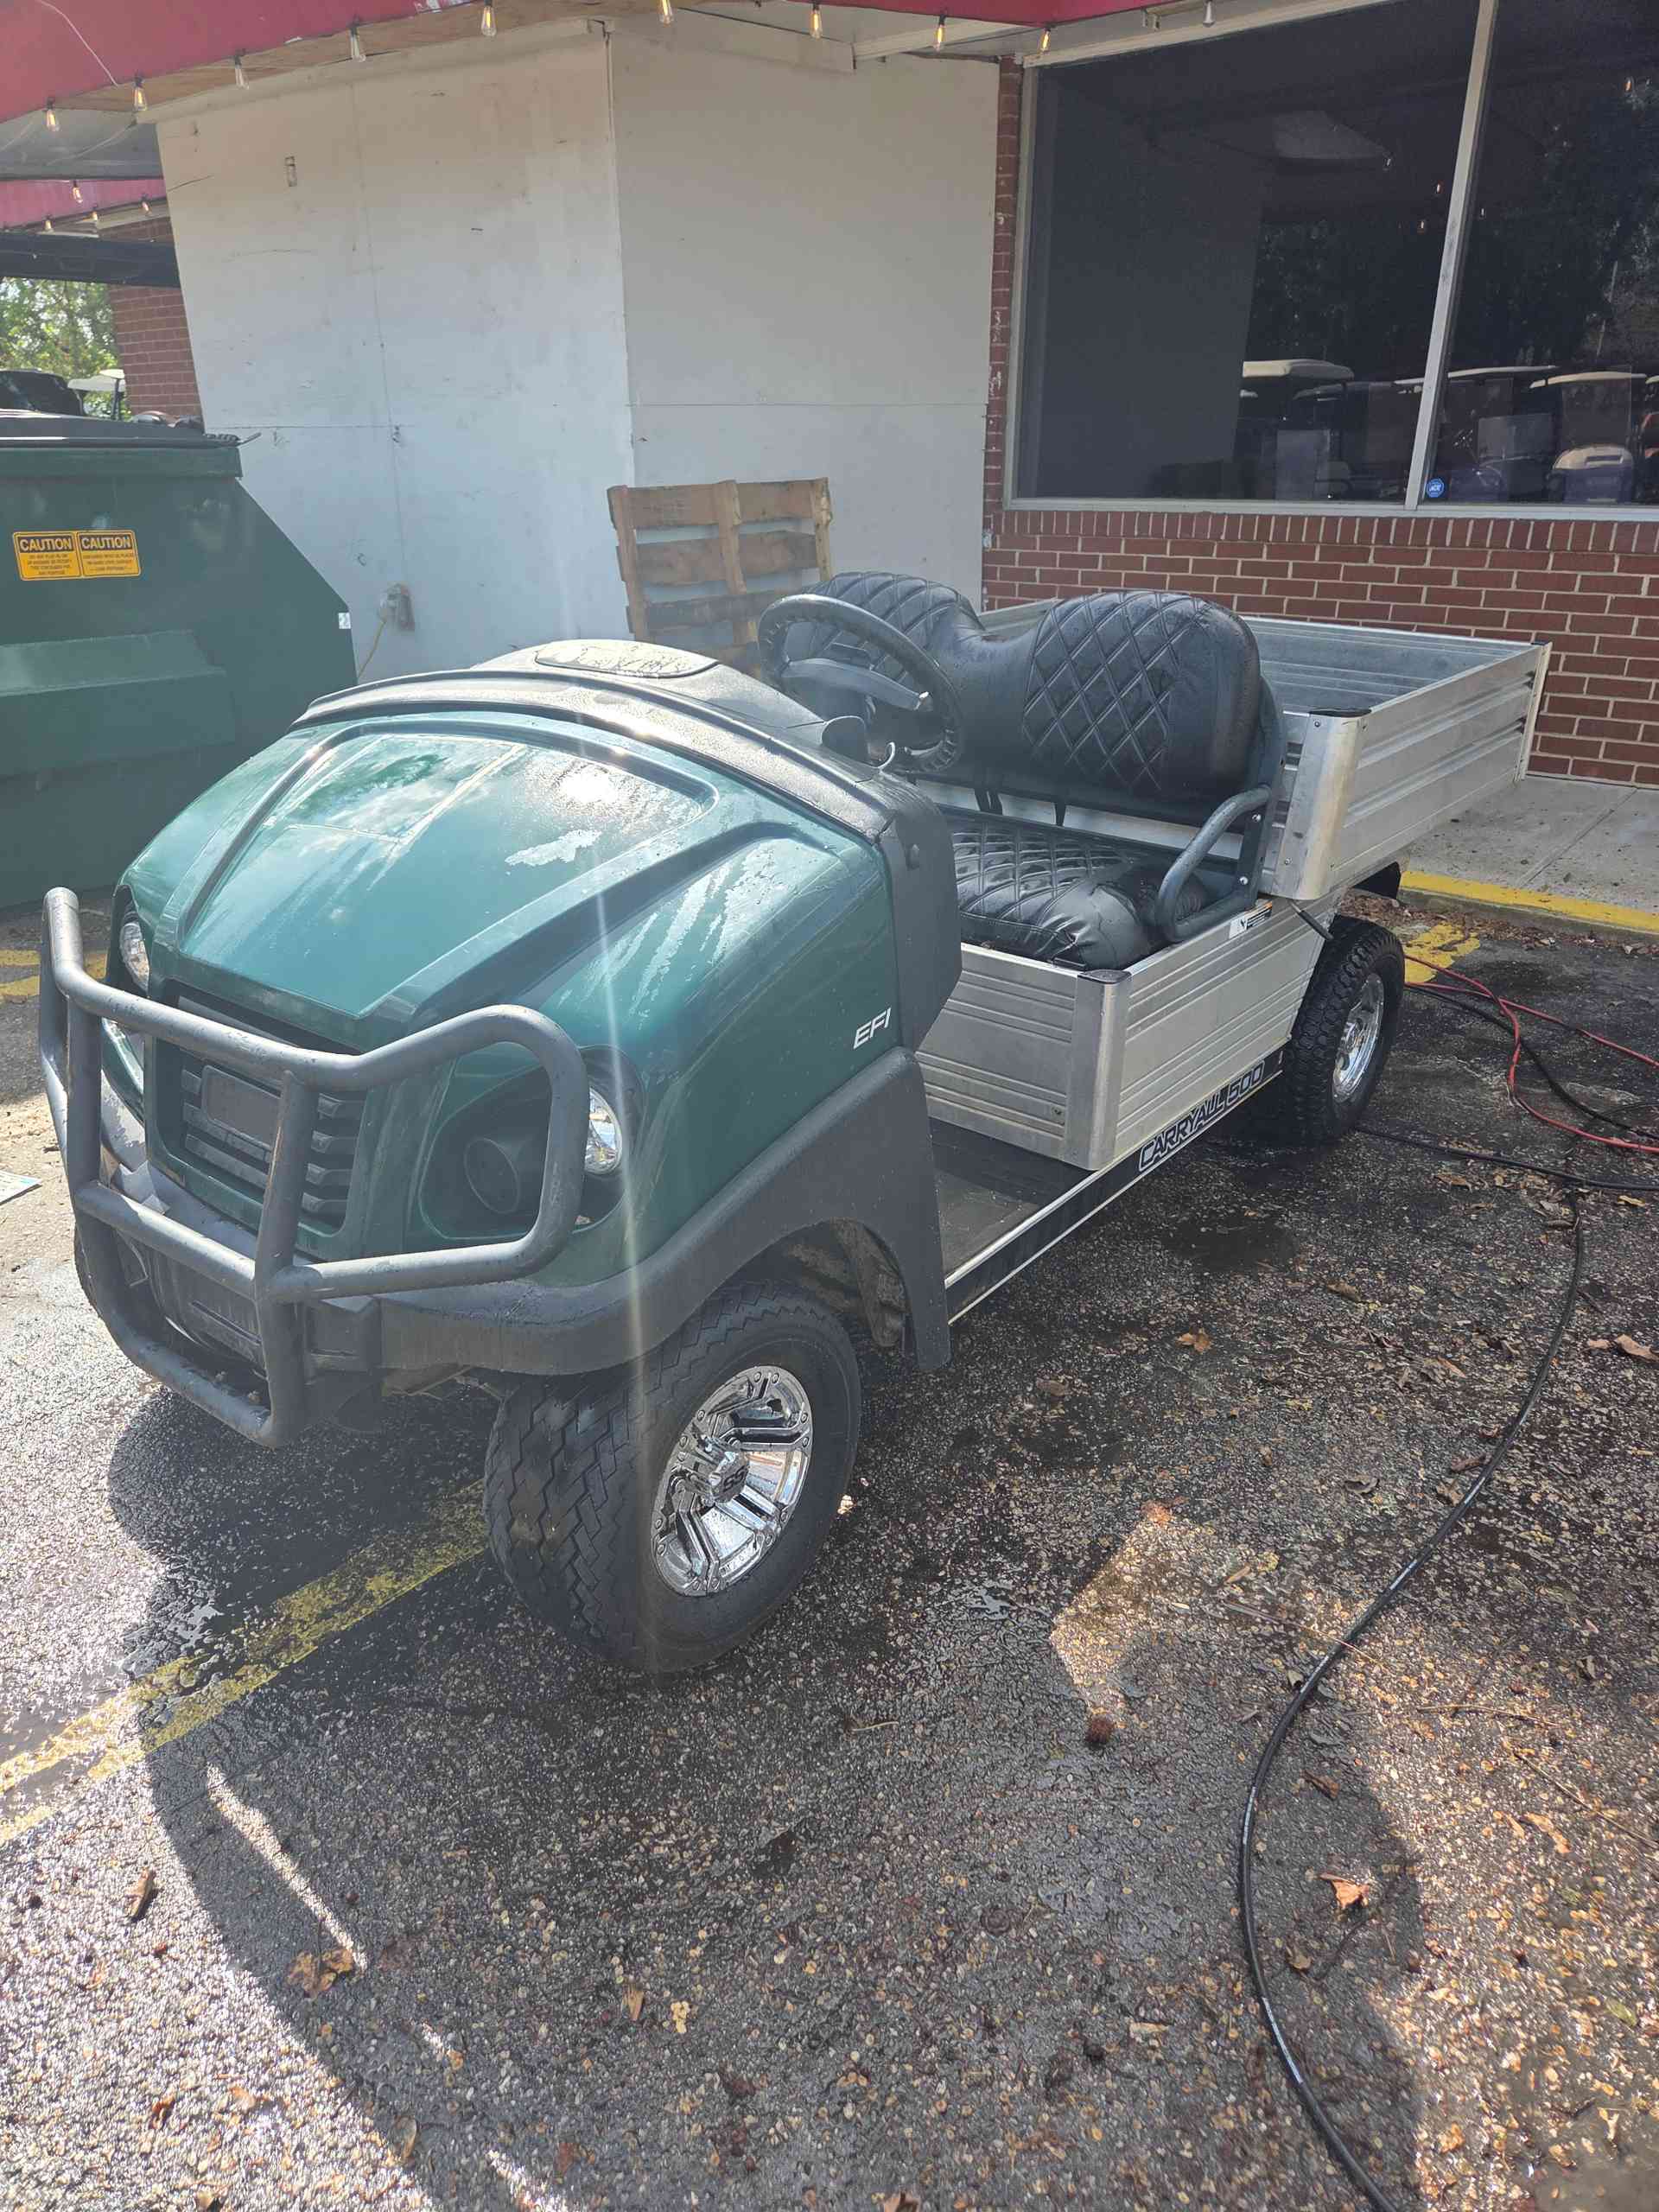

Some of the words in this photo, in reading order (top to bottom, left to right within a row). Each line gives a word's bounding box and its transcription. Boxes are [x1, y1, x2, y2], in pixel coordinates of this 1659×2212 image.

[20, 537, 72, 551] CAUTION
[81, 537, 131, 550] CAUTION
[853, 1007, 892, 1050] EFI
[1139, 1090, 1225, 1172] CARRYALL
[1226, 1059, 1265, 1107] 500
